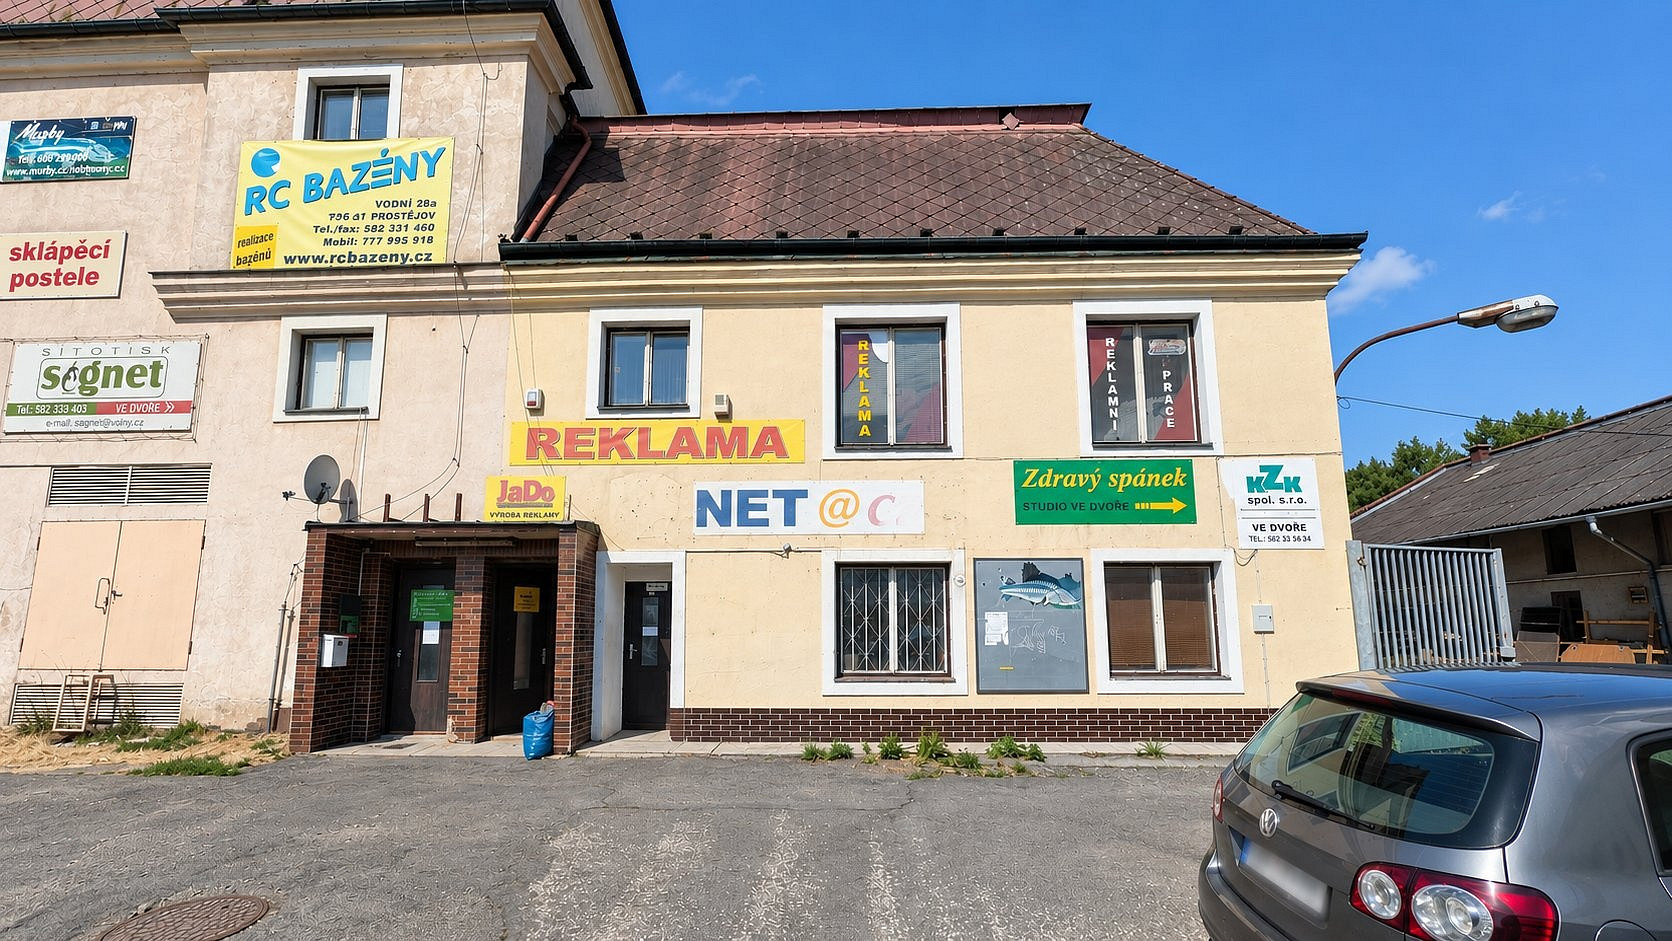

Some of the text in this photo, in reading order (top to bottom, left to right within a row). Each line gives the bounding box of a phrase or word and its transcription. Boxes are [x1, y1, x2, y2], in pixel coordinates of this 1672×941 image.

[244, 147, 446, 216] RC BAZÉNY
[375, 198, 437, 208] VODNÍ 28a
[313, 223, 435, 235] Tel./fax: 582 331 460
[237, 233, 274, 248] realizace
[323, 235, 434, 247] Mobil: 777 995 918
[9, 239, 112, 265] sklápěcí
[283, 251, 433, 266] www.rcbazeny.cz
[9, 266, 99, 292] postele
[42, 346, 171, 357] SITOTISK
[857, 340, 872, 437] REKLAMA
[35, 404, 51, 414] 582
[53, 404, 69, 414] 333
[71, 404, 87, 413] 403
[116, 403, 127, 413] VE
[525, 426, 790, 460] REKLAMA
[1021, 467, 1187, 493] Zdravý spánek
[497, 480, 556, 502] JaDo
[696, 489, 808, 527] NET
[1023, 500, 1129, 511] STUDIO VE DVOŘE
[1248, 495, 1307, 506] spol. s.r.o.
[1252, 521, 1307, 532] VE DVOŘE
